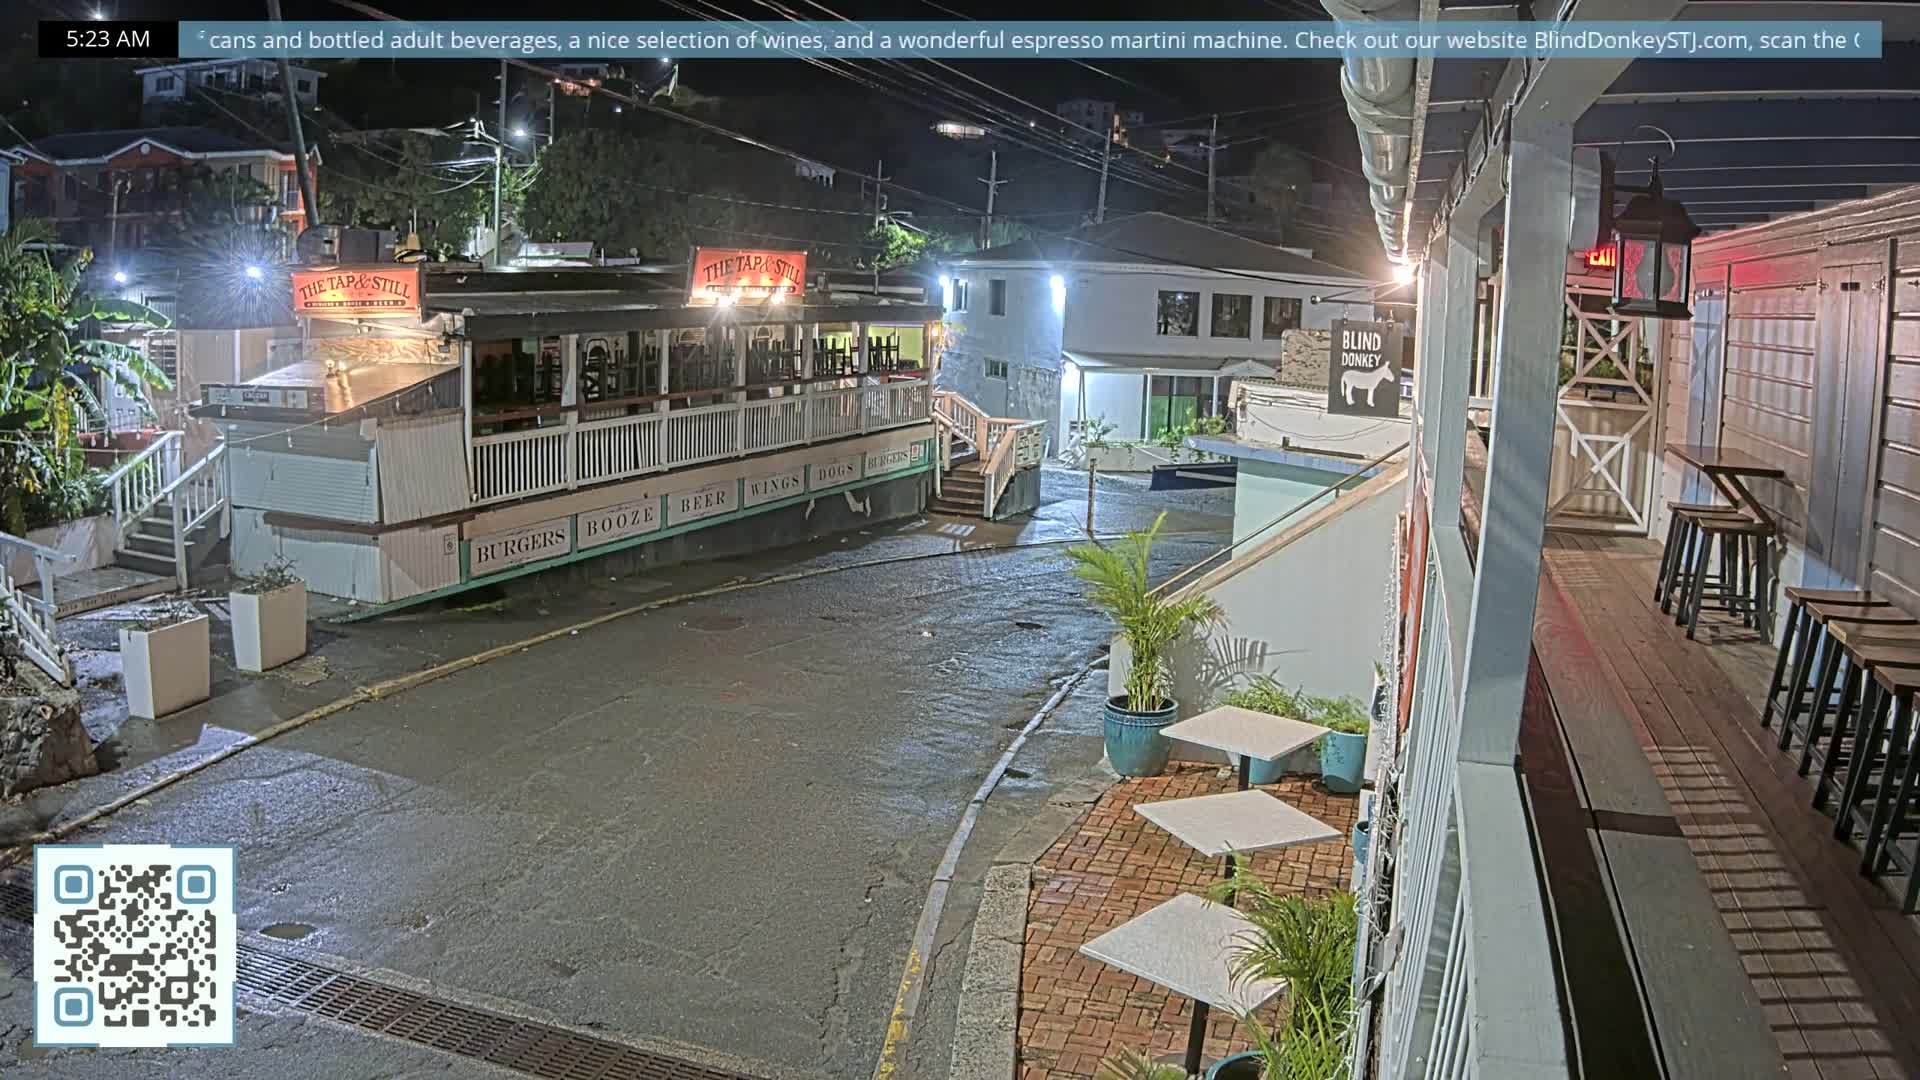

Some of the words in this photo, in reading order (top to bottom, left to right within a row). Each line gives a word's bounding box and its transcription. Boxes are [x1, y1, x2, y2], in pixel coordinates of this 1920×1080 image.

[703, 258, 734, 283] THE
[736, 255, 762, 273] TAP
[760, 255, 777, 274] &
[774, 258, 801, 285] STILL
[300, 279, 327, 300] THE
[327, 275, 356, 290] TAP
[354, 273, 373, 289] &
[371, 276, 411, 299] STILL
[1342, 330, 1382, 351] BLIND
[1341, 351, 1382, 368] DONKEY
[818, 462, 854, 482] DOGS
[867, 450, 909, 470] BURGERS
[750, 475, 800, 498] WINGS
[681, 489, 727, 514] BEER
[586, 506, 654, 537] BOOZE
[477, 528, 566, 564] BURGERS
